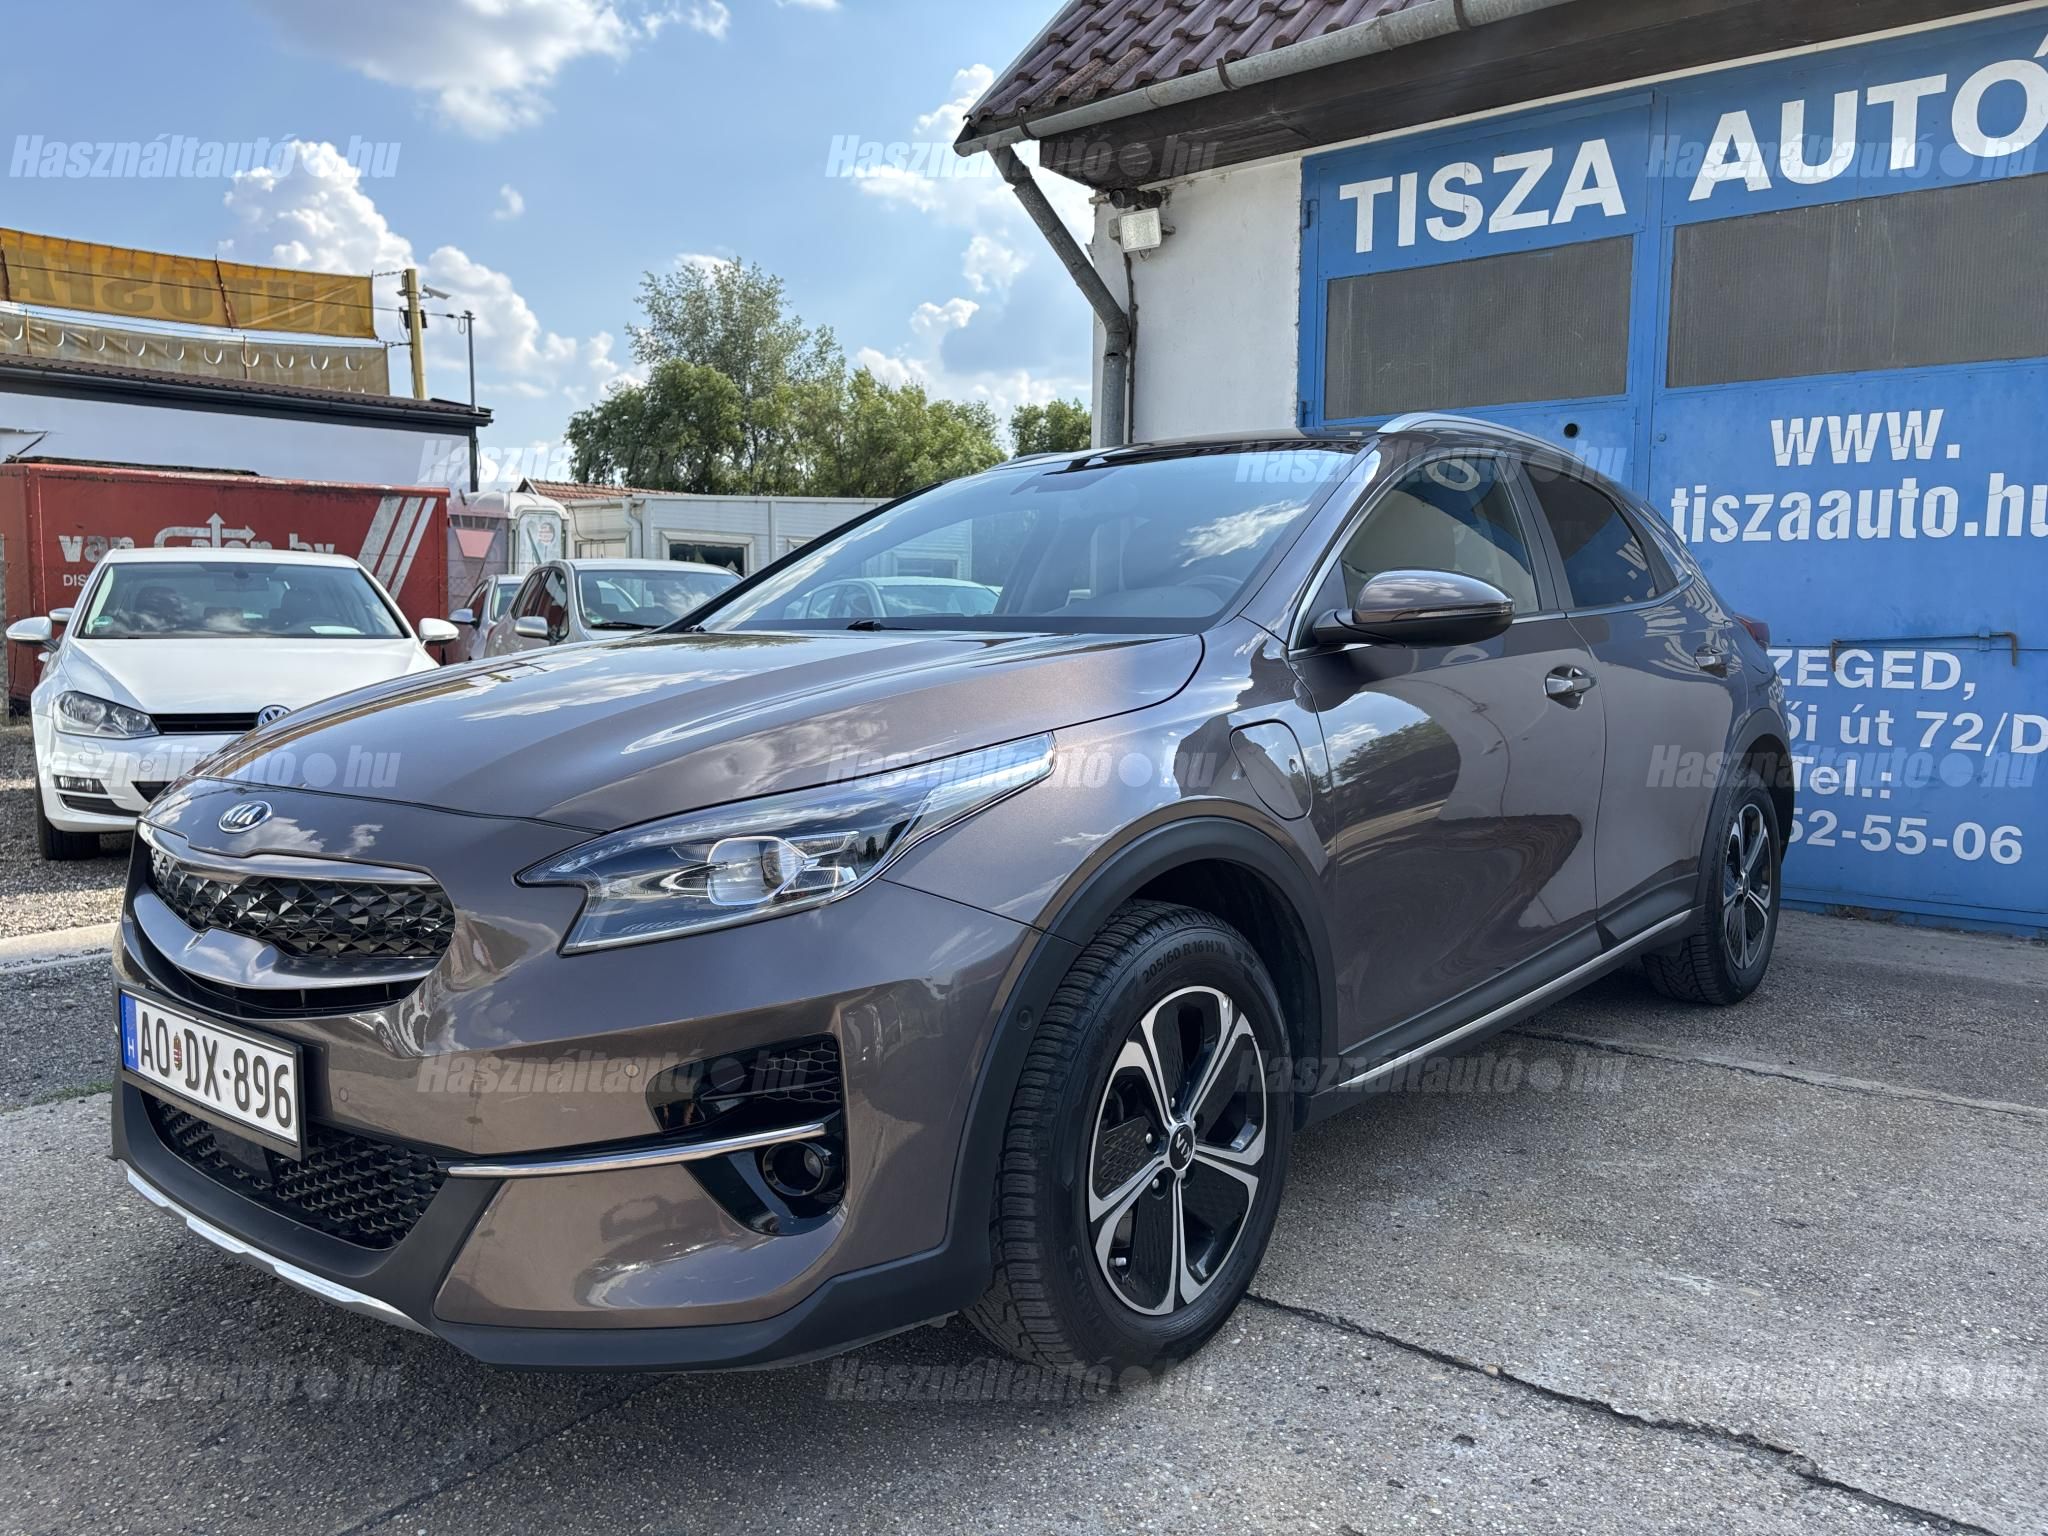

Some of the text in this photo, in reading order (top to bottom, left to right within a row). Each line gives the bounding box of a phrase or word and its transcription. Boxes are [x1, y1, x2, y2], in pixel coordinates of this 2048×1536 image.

[1339, 138, 1627, 253] TISZA
[1770, 409, 1960, 466] www.
[1671, 473, 2048, 545] tiszaauto.hu
[1840, 704, 1894, 746] út
